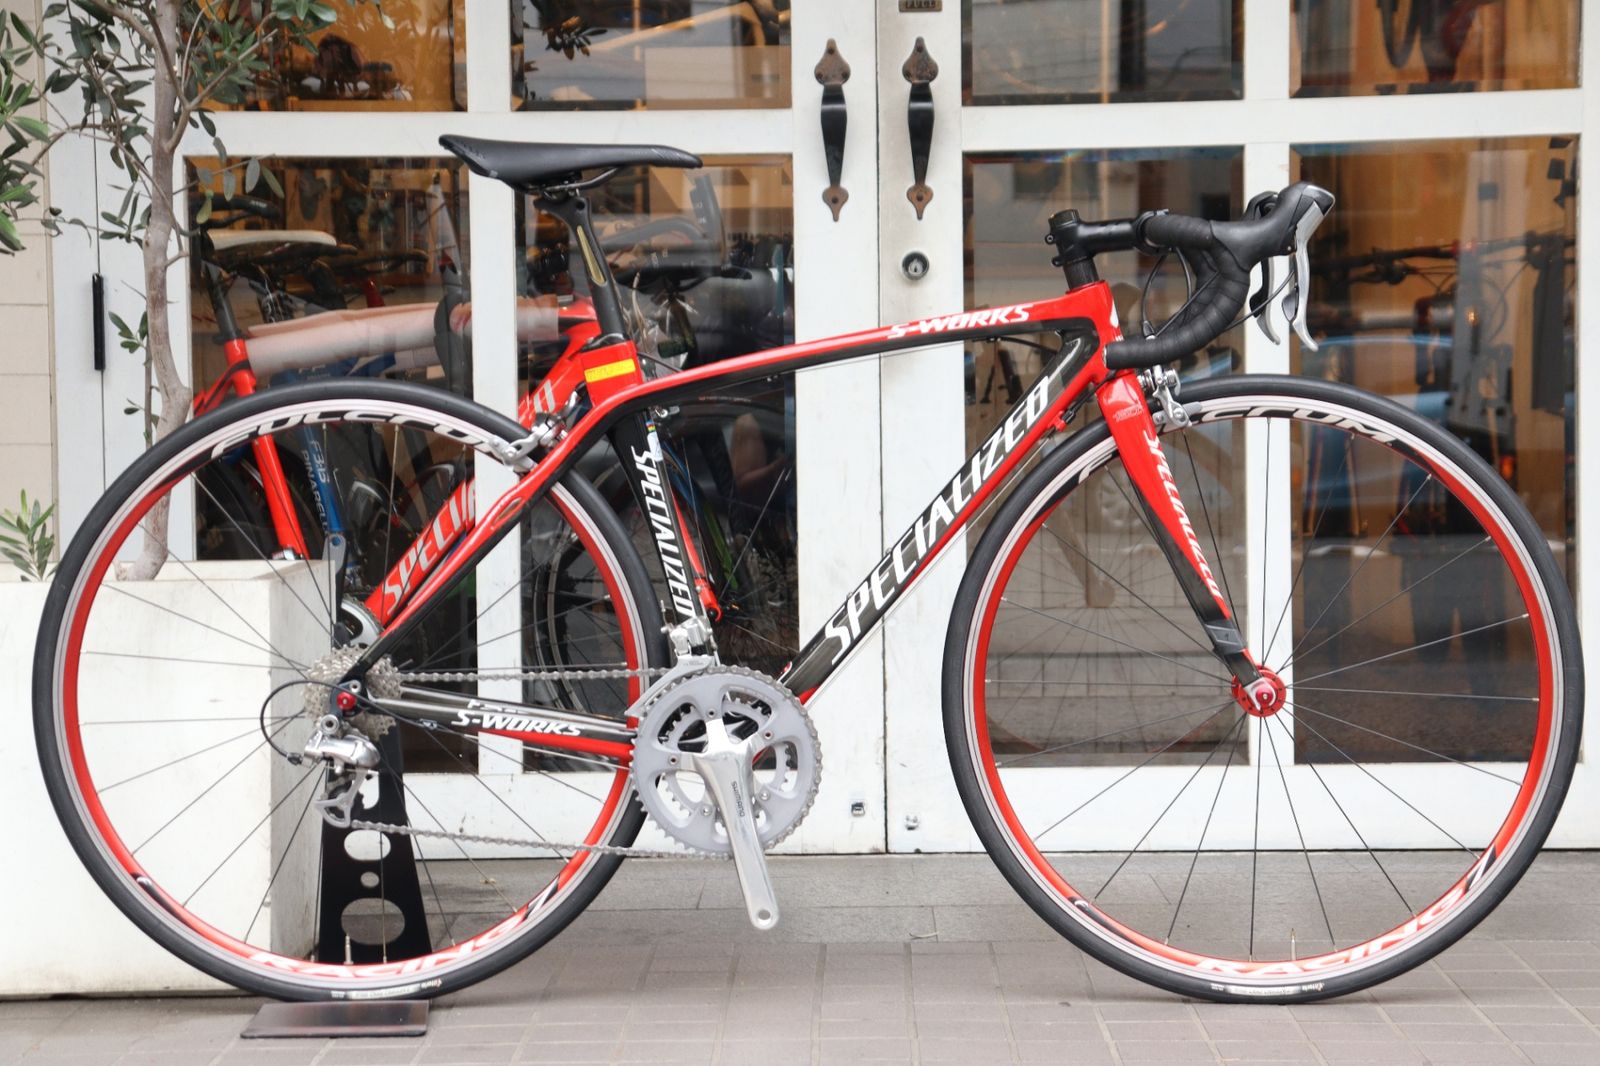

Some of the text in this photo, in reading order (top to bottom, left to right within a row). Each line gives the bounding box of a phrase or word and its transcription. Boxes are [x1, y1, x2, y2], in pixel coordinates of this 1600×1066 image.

[887, 304, 1034, 339] S-WORKS
[1078, 405, 1393, 484] FCRUM
[631, 445, 696, 618] SPECIALIZED
[825, 375, 1050, 664] SPECIALIZED
[451, 709, 586, 737] S-WORKS
[248, 912, 526, 979] RACING
[1196, 886, 1466, 976] RACING
